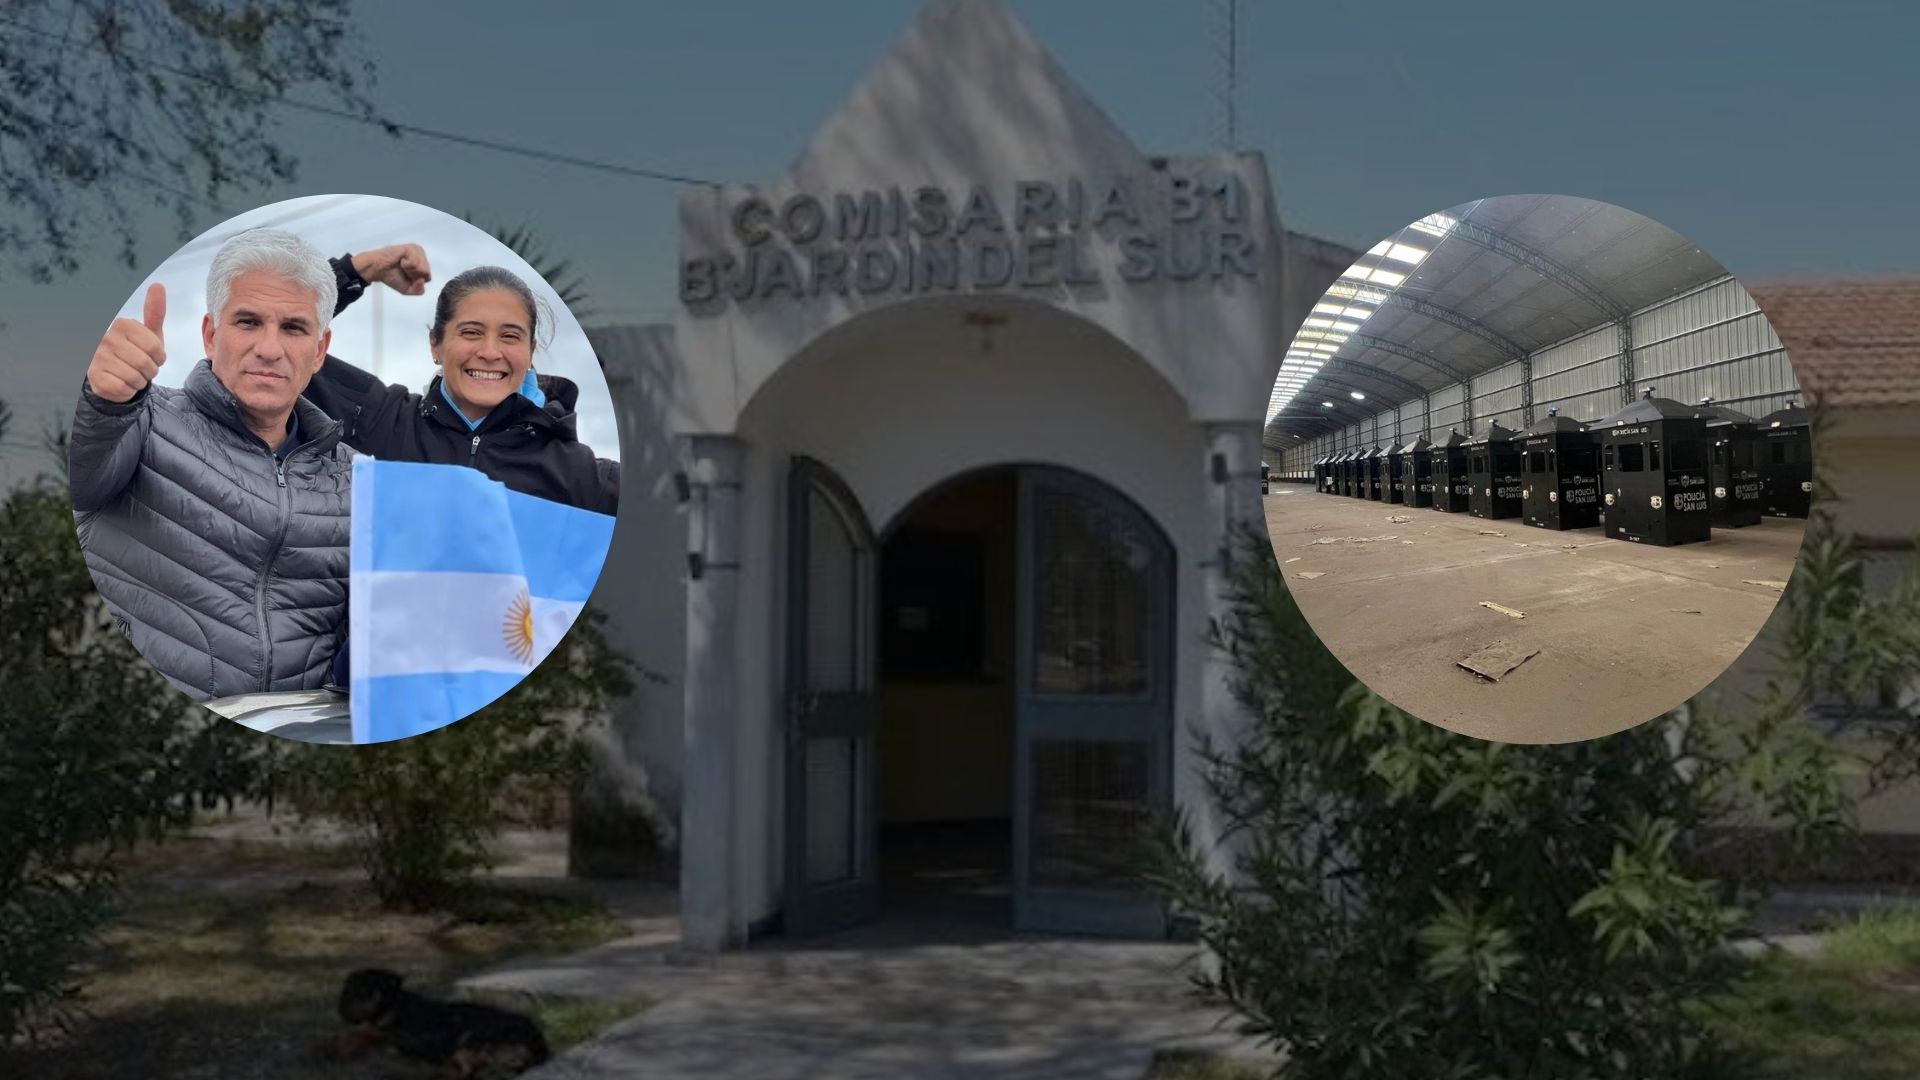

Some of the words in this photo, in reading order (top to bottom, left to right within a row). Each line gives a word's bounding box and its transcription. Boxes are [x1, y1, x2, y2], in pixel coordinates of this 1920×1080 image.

[732, 177, 1143, 246] COMISARIA
[1117, 230, 1258, 281] SUR
[1683, 502, 1696, 512] SAN
